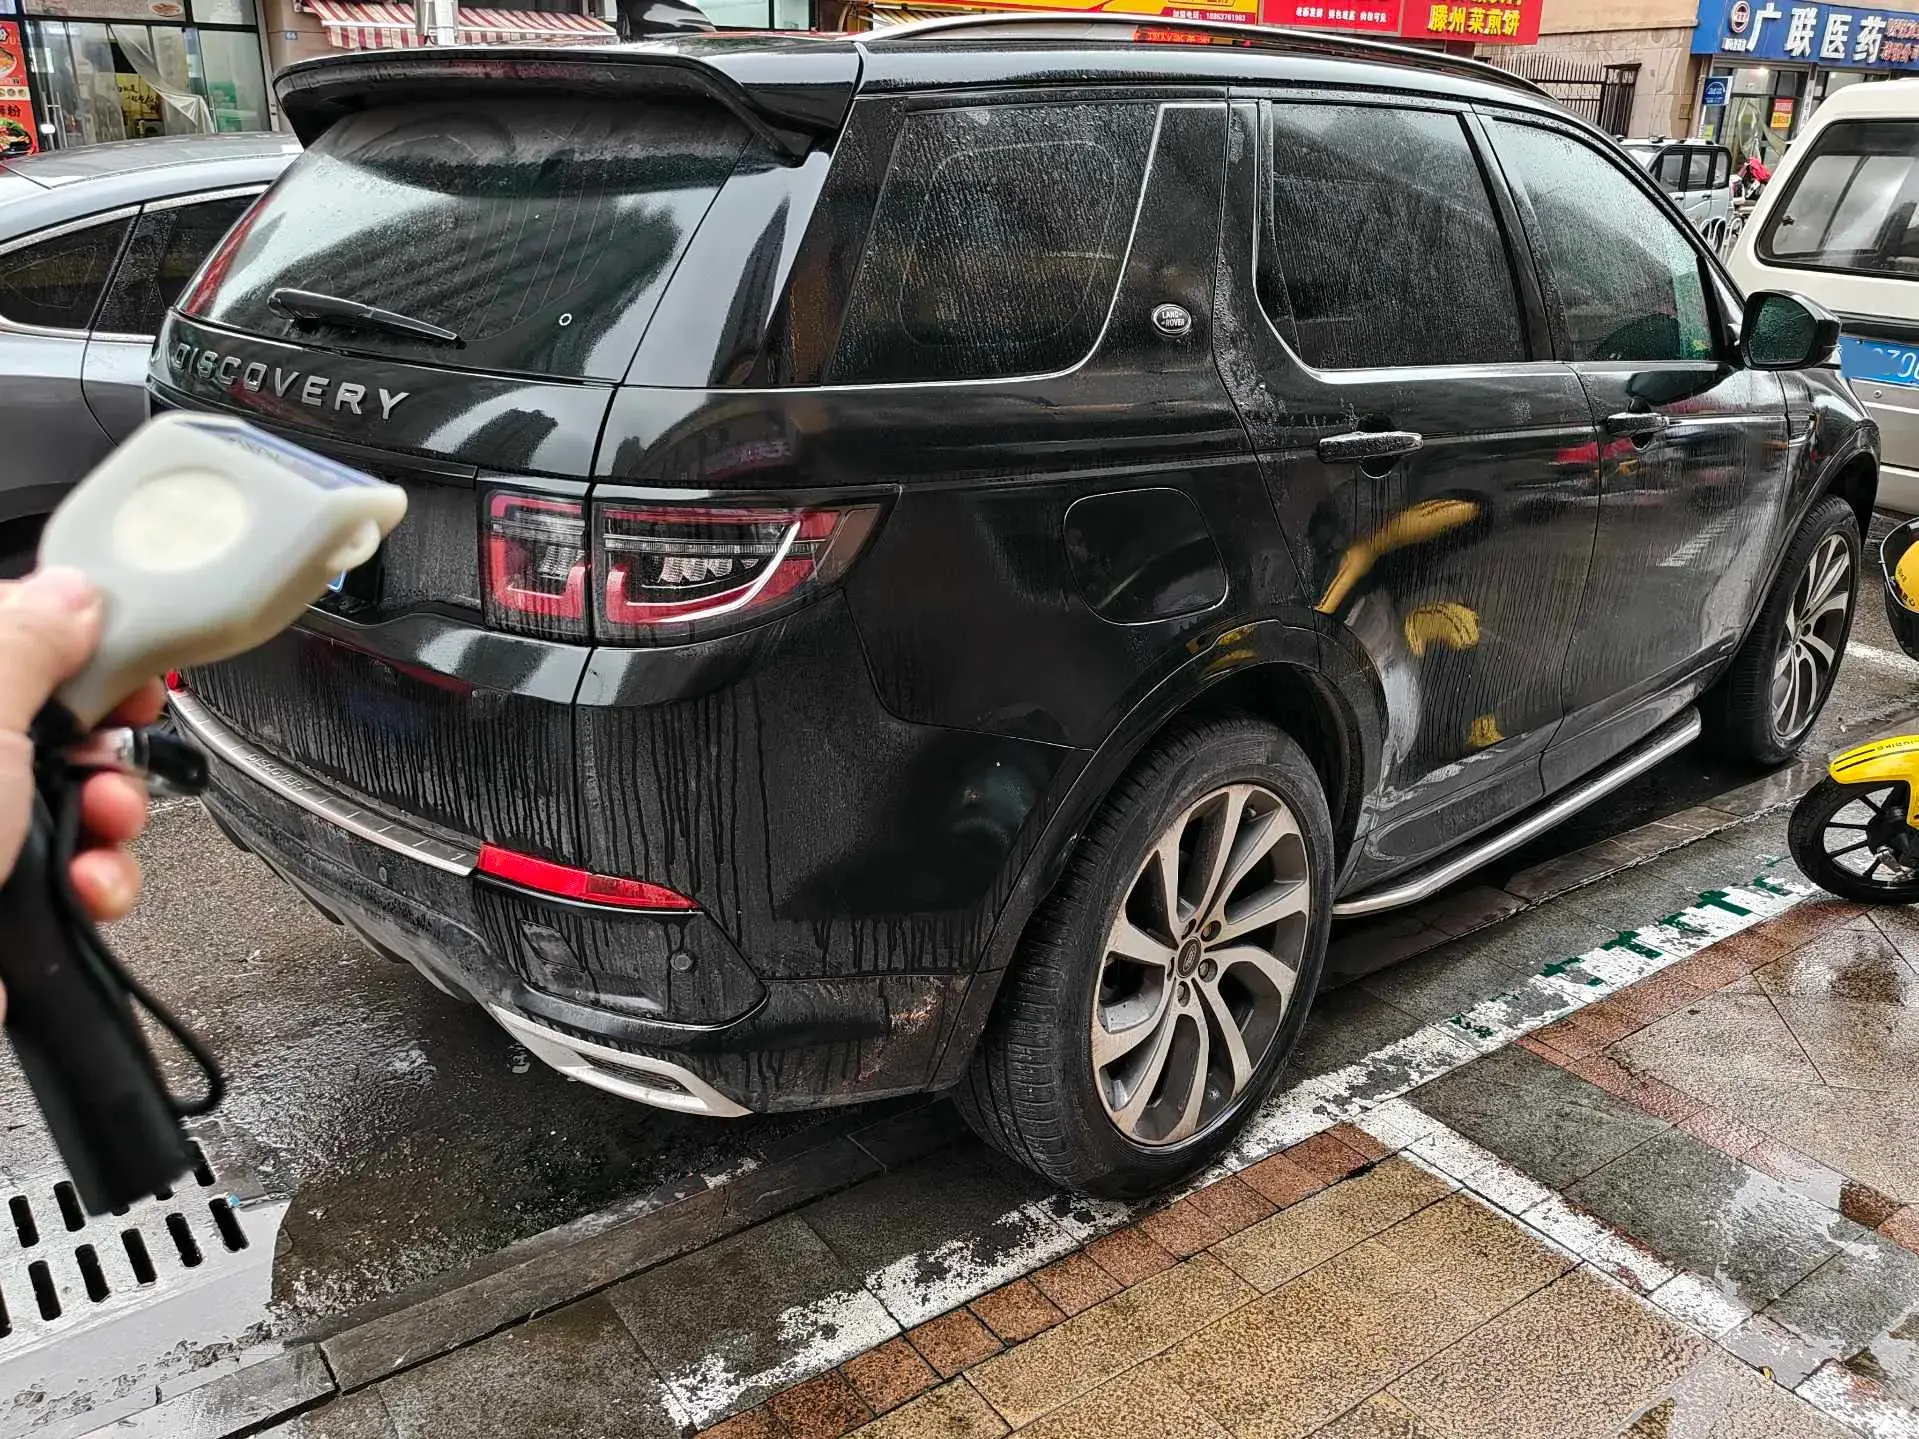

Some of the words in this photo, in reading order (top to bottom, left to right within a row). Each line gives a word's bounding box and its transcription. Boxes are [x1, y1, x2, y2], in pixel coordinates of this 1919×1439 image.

[1746, 3, 1886, 64] 广联医药
[175, 342, 410, 420] DISCOVERY
